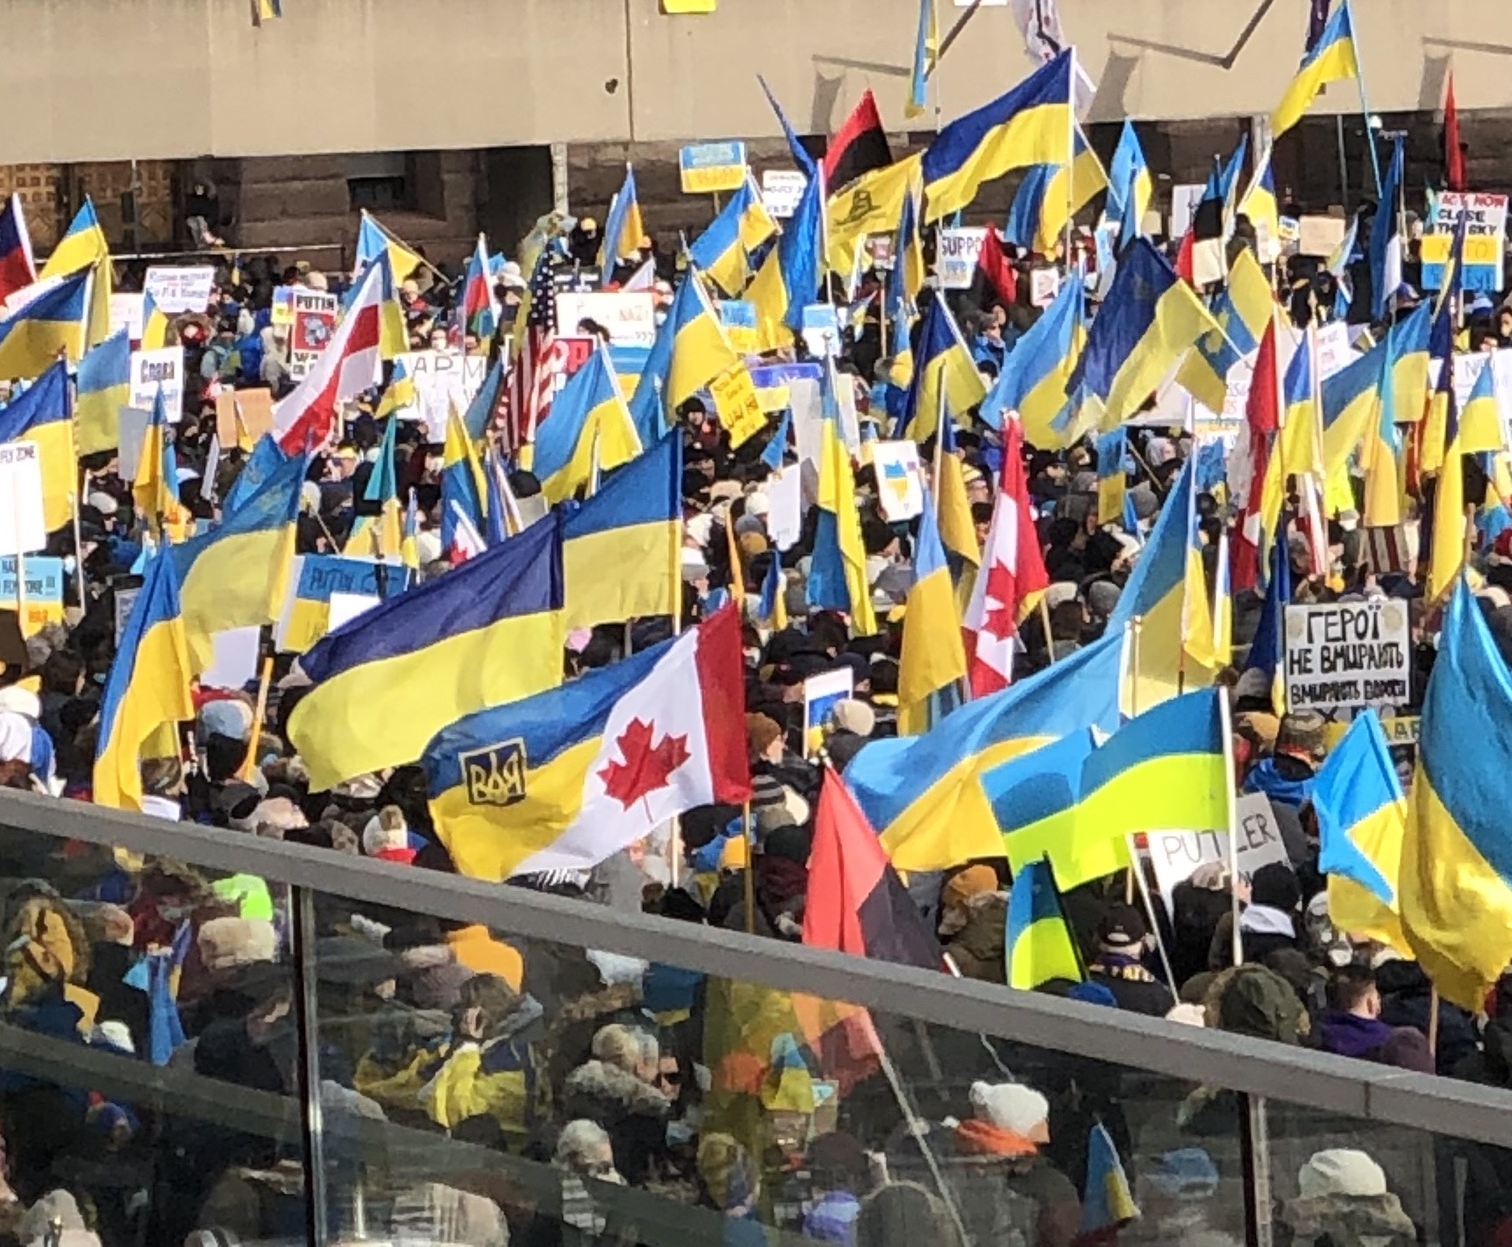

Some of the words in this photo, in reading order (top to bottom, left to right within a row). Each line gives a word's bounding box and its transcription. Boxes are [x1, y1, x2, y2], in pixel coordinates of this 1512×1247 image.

[1438, 208, 1485, 223] CLSE
[296, 294, 335, 311] PUTIN
[1306, 604, 1381, 644] ГЕРОЇ
[1289, 647, 1314, 676] НЕ
